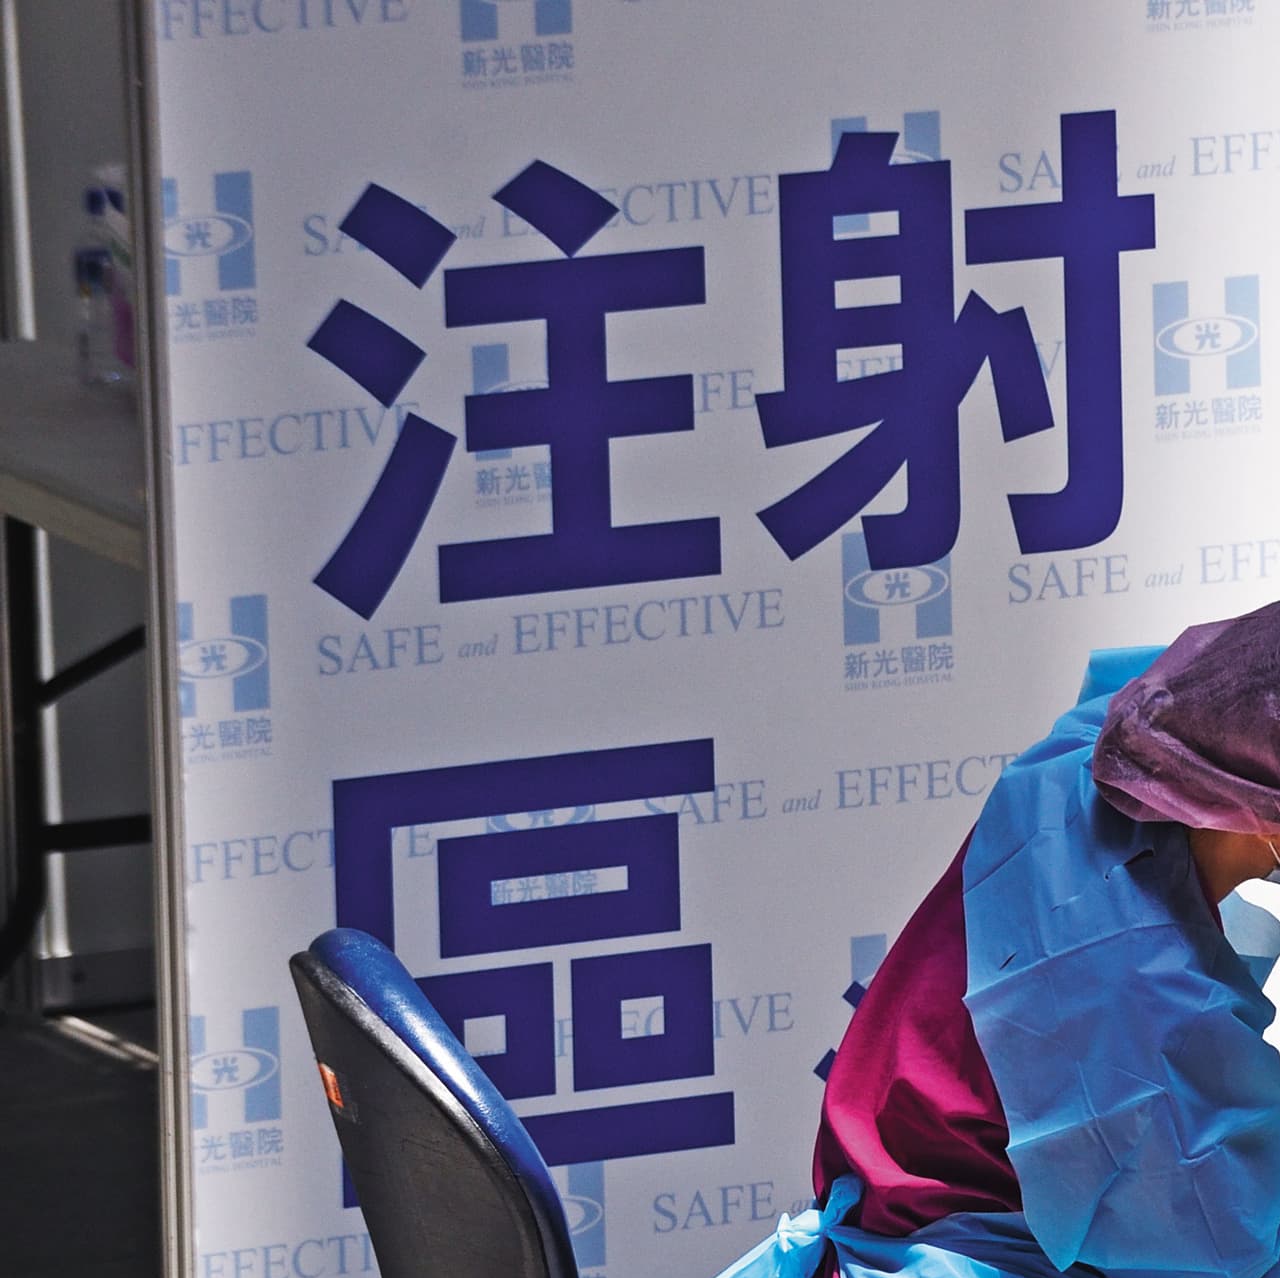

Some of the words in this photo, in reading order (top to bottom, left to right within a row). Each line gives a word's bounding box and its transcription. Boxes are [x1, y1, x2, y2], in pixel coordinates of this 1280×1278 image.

[462, 41, 574, 77] 新光醫院
[1137, 156, 1177, 179] and
[307, 109, 1156, 621] 注射
[1155, 395, 1262, 430] 新光醫院
[884, 571, 911, 601] 光
[1008, 554, 1131, 604] SAFE
[1145, 564, 1185, 588] and
[318, 624, 445, 676] SAFE
[457, 634, 499, 659] and
[512, 589, 785, 655] EFFECTIVE
[844, 642, 955, 681] 新光醫院
[183, 716, 272, 752] 光醫院
[782, 789, 822, 814] and
[333, 737, 735, 1208] 區
[195, 1126, 283, 1163] 光醫院
[653, 1181, 776, 1234] SAFE
